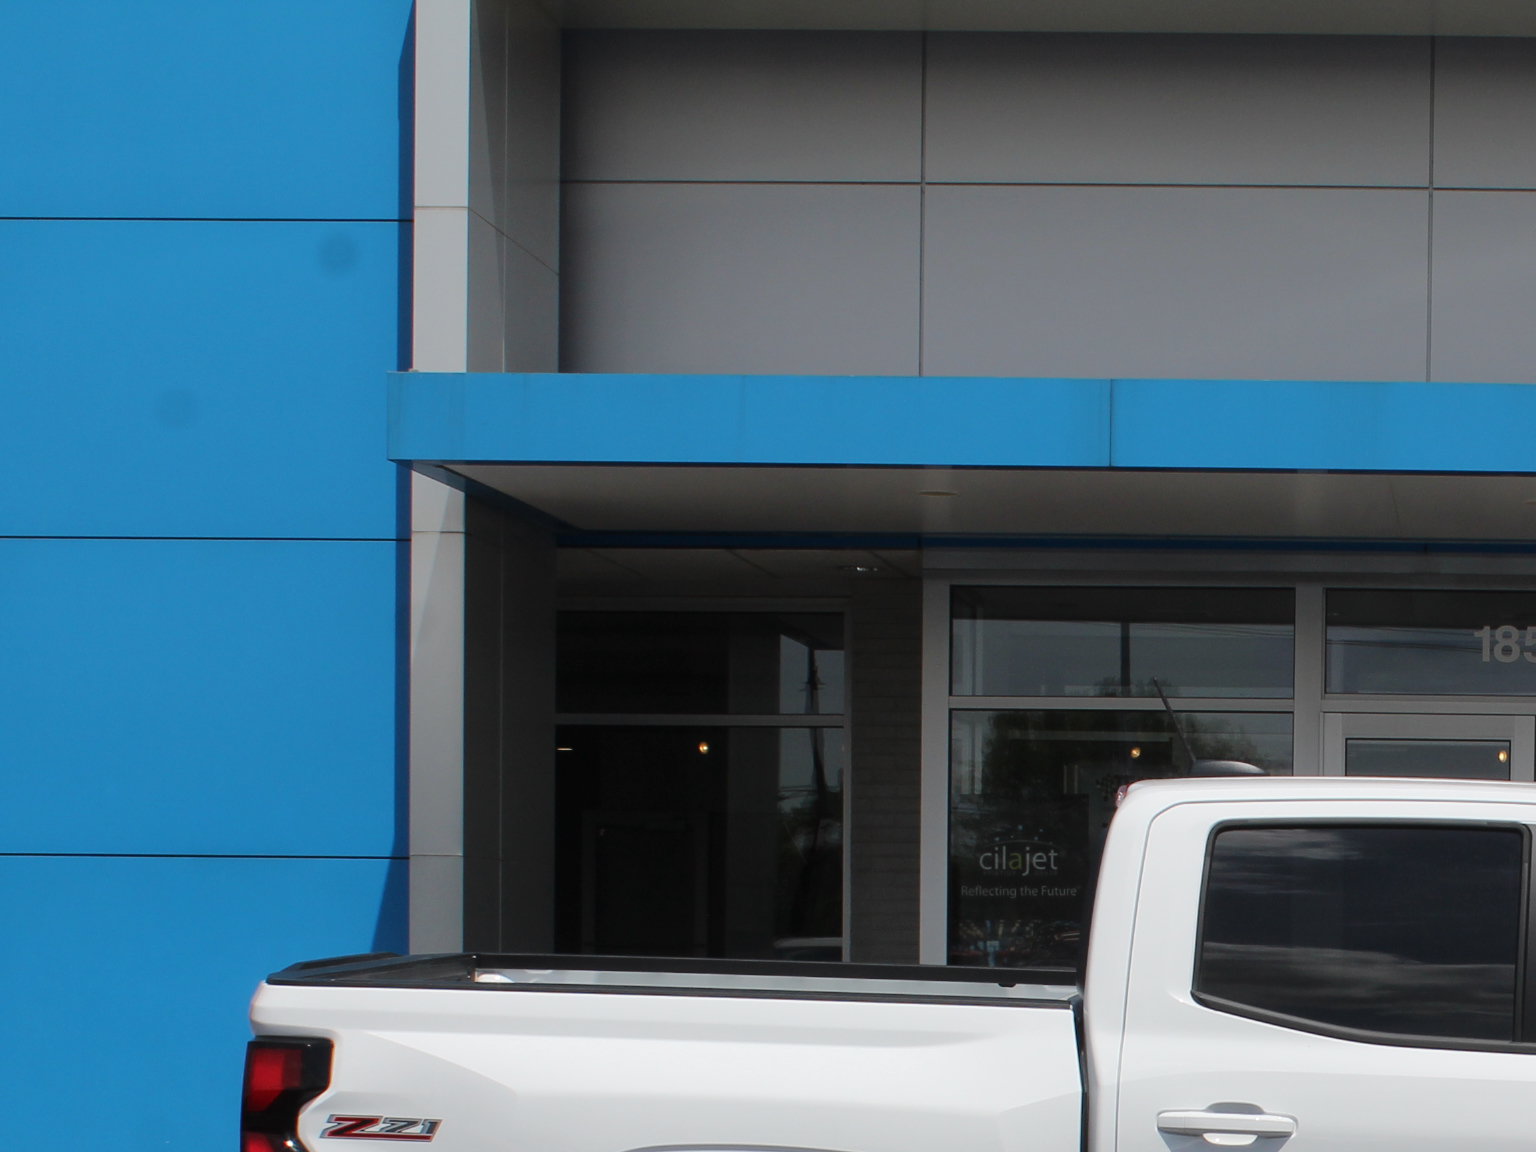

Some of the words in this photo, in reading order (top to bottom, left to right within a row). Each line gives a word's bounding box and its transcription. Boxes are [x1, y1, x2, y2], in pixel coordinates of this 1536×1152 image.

[979, 845, 1059, 876] cilajet
[960, 885, 1017, 898] Reflecting
[1020, 885, 1038, 896] the
[1041, 885, 1077, 896] Future
[319, 1113, 443, 1143] Z71
